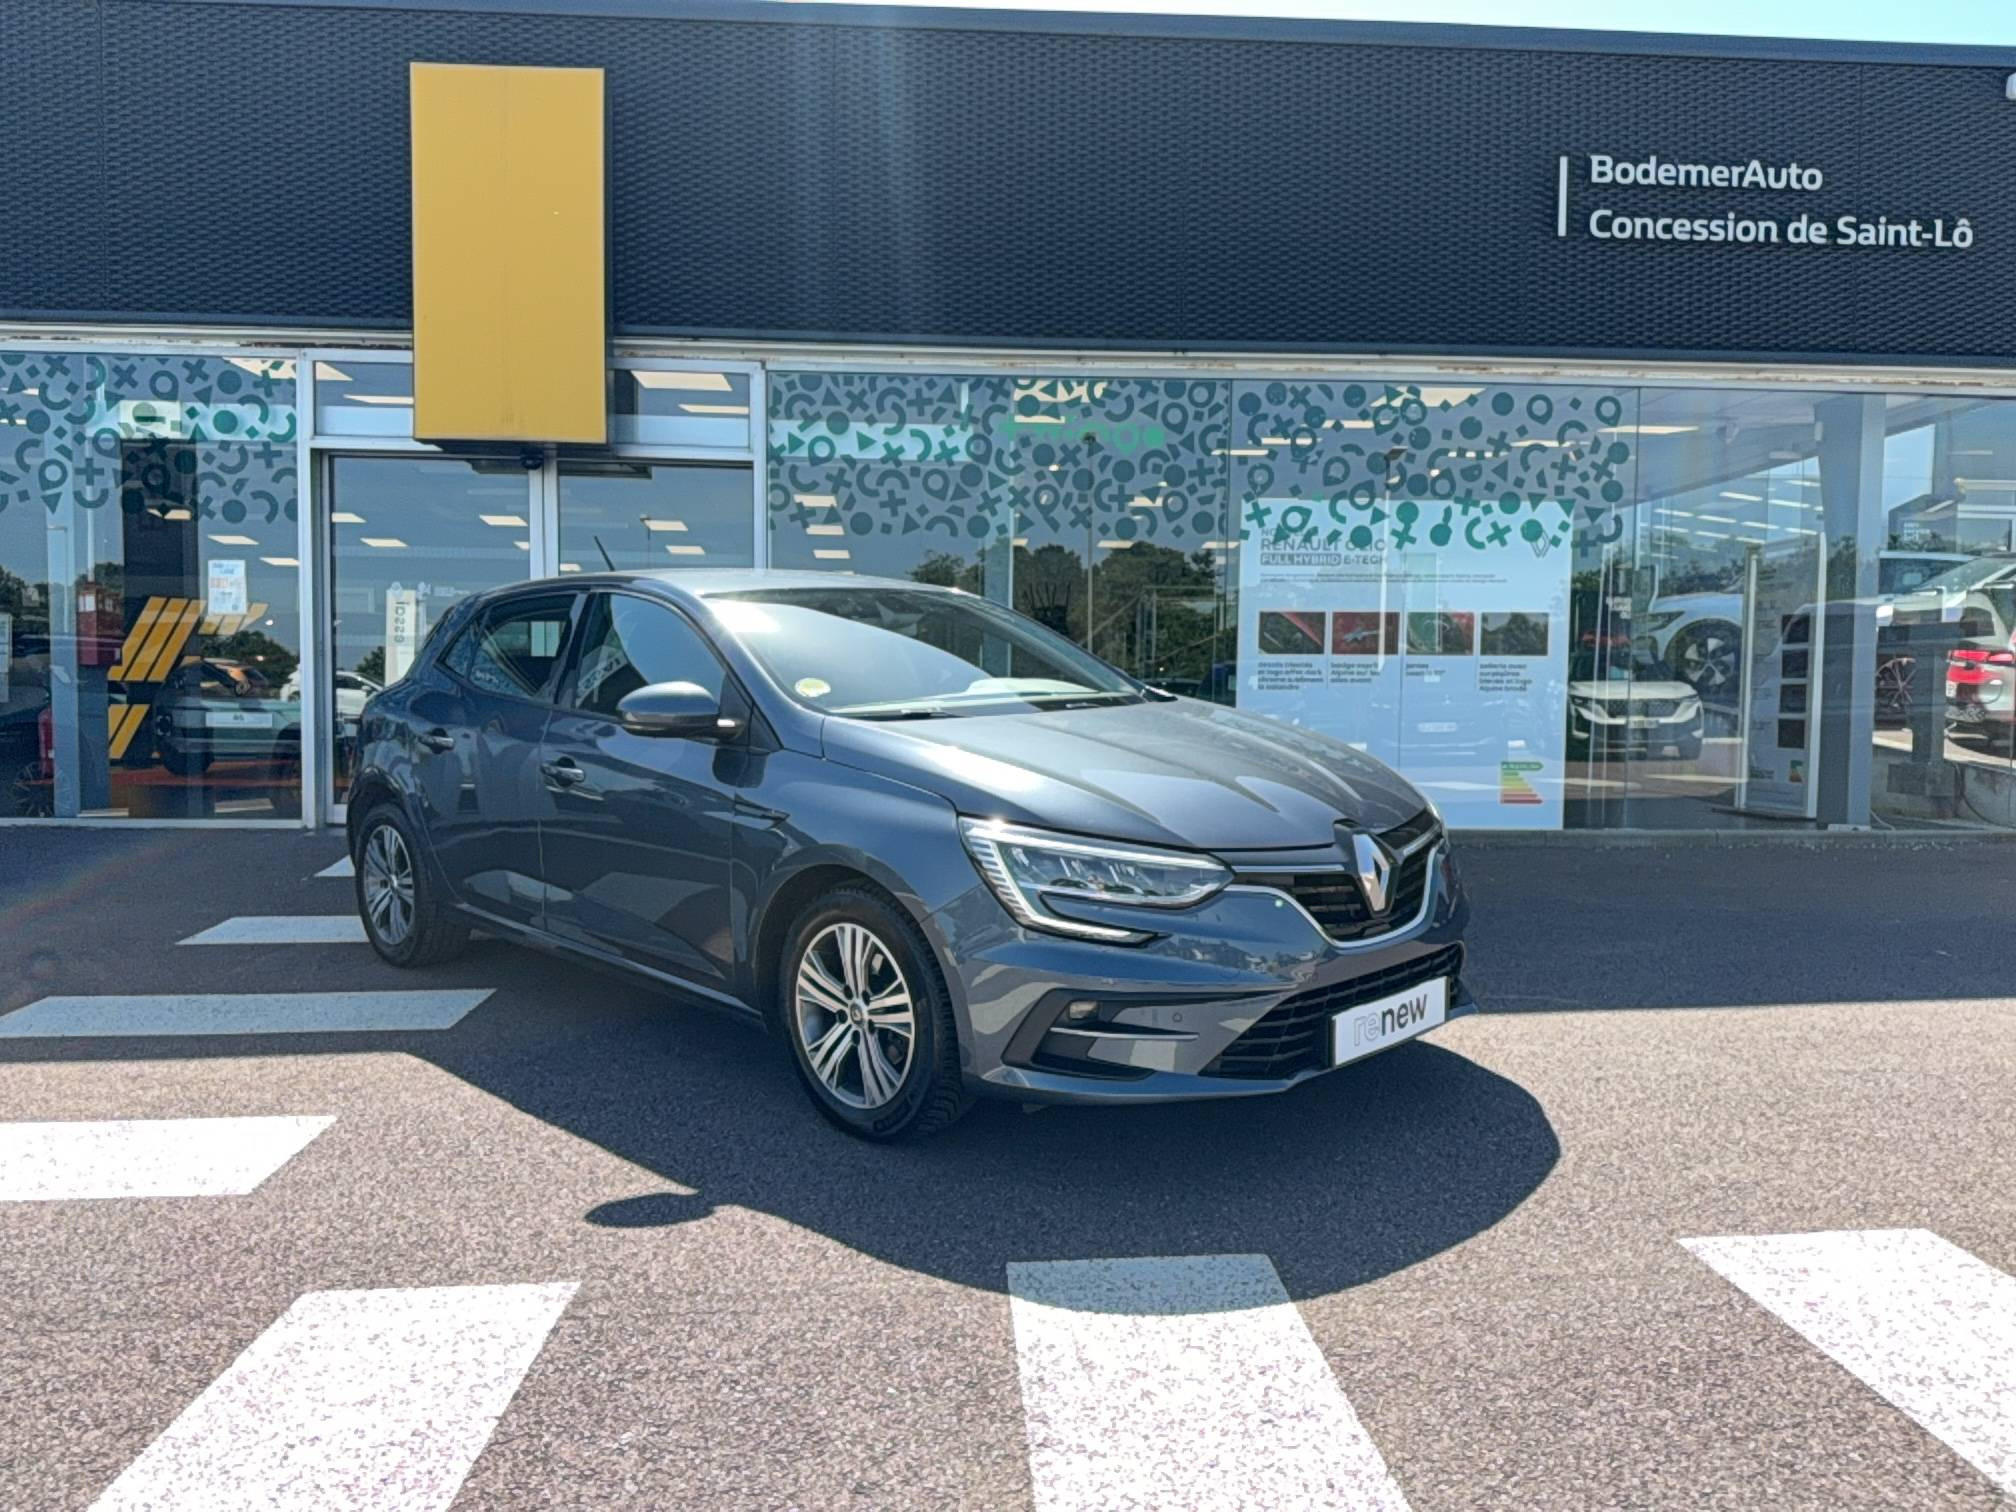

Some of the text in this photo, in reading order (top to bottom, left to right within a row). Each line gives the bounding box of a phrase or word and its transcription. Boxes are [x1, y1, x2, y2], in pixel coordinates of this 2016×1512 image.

[1589, 154, 1824, 191] BodemerAuto
[1589, 209, 1974, 249] Concession de Saint-Lô
[1262, 554, 1292, 565] FULL
[1294, 554, 1340, 565] HYBRID
[1353, 993, 1428, 1048] renew
